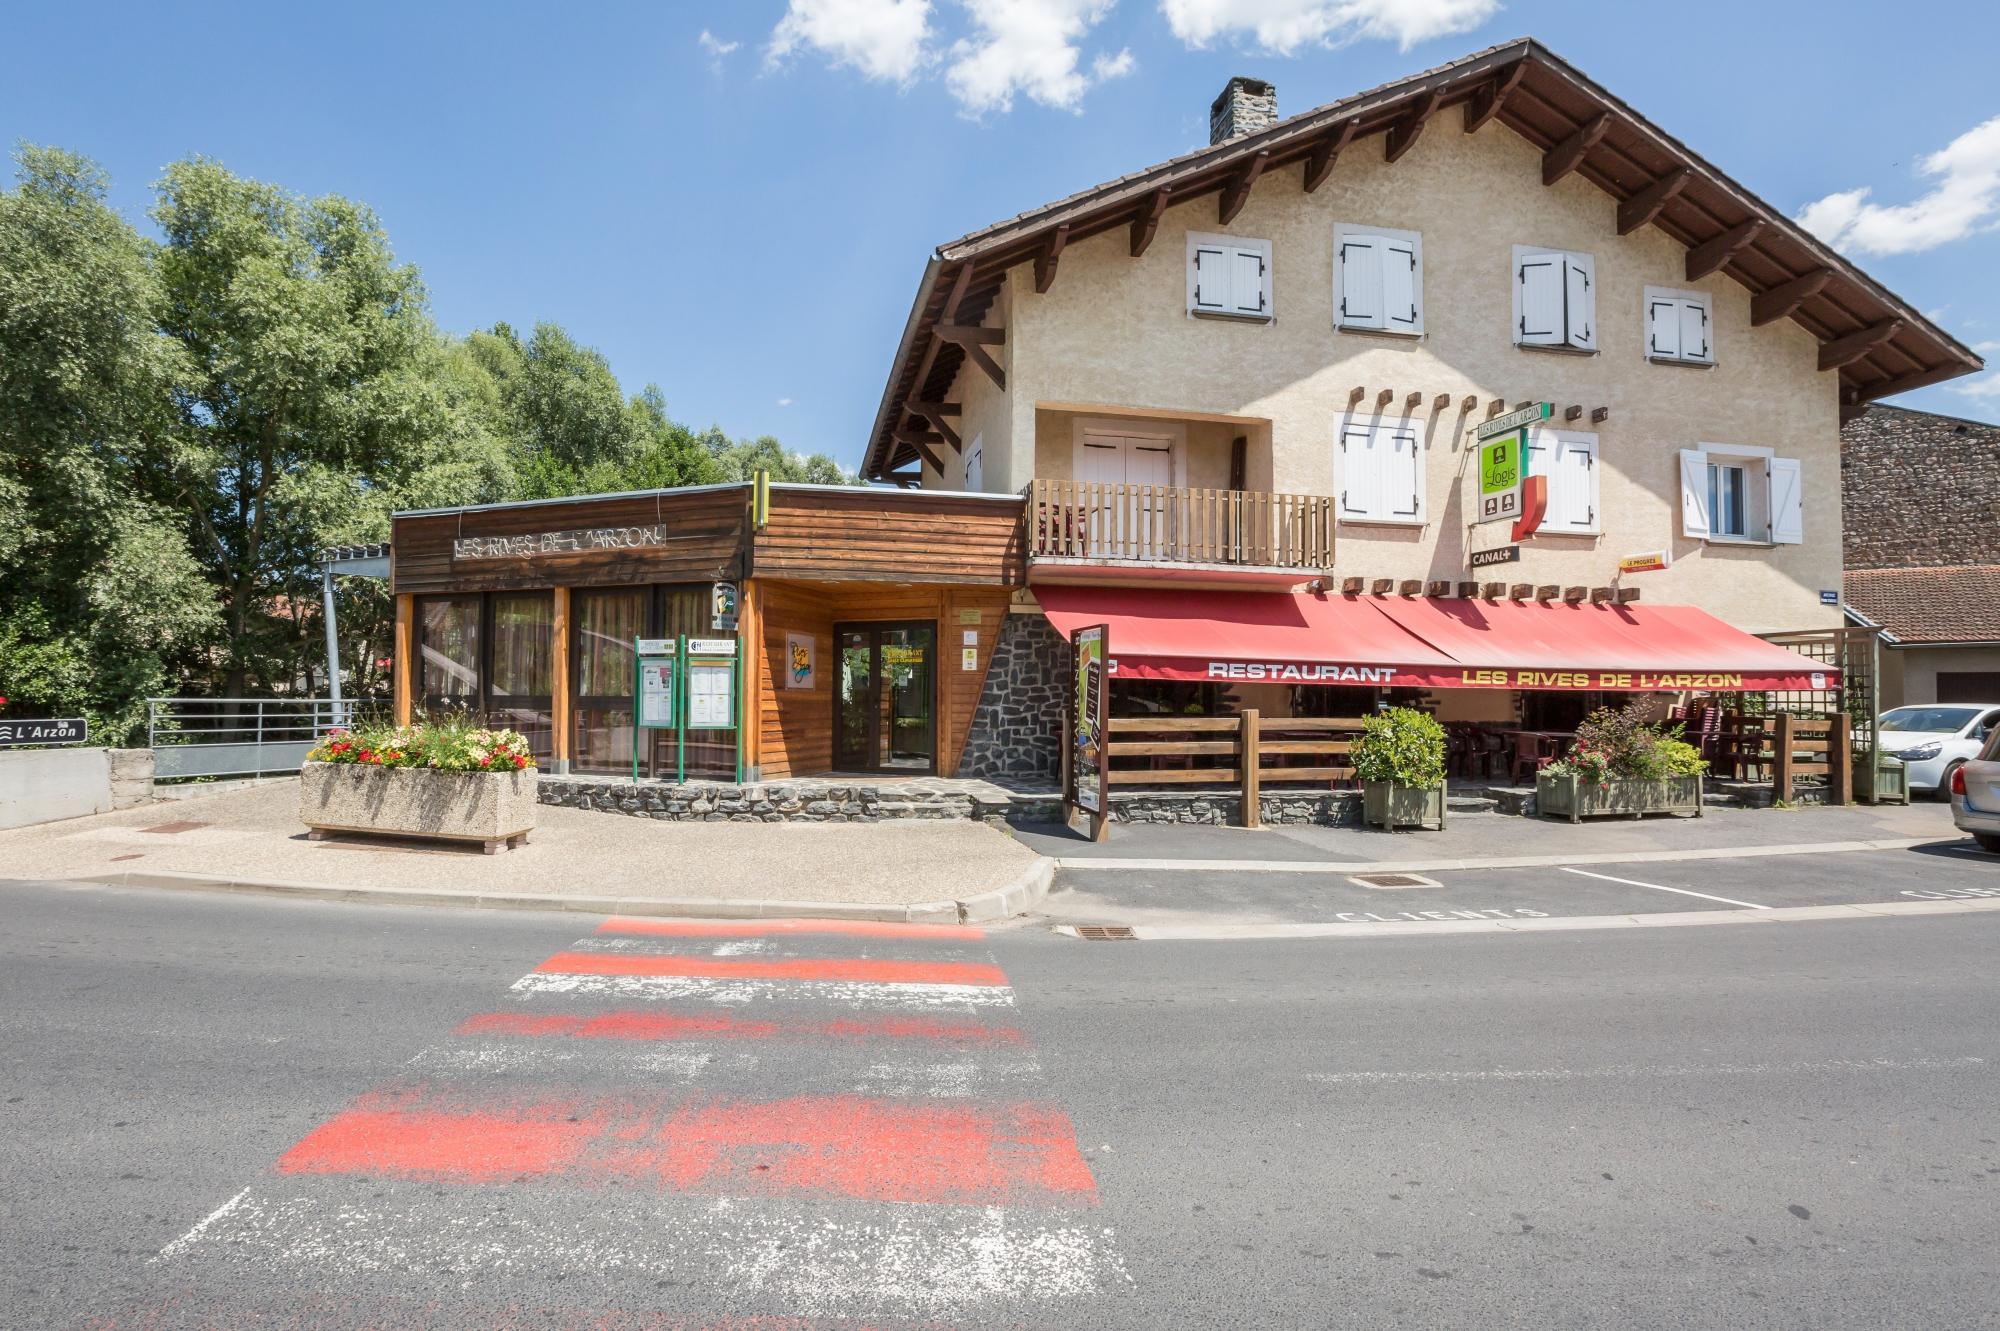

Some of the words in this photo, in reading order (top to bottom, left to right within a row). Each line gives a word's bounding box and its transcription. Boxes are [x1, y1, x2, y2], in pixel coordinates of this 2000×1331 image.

[1485, 465, 1516, 489] Logis
[455, 540, 482, 558] LES
[541, 532, 561, 552] DE
[1473, 552, 1511, 565] CANAL+
[1208, 662, 1397, 683] RESTAURANT
[1462, 670, 1508, 685] LES
[1517, 671, 1590, 687] RIVES
[1600, 673, 1632, 687] DE
[1640, 674, 1742, 688] L'ARZON
[16, 726, 76, 739] L'Arzon
[1336, 908, 1549, 922] CLIENTS
